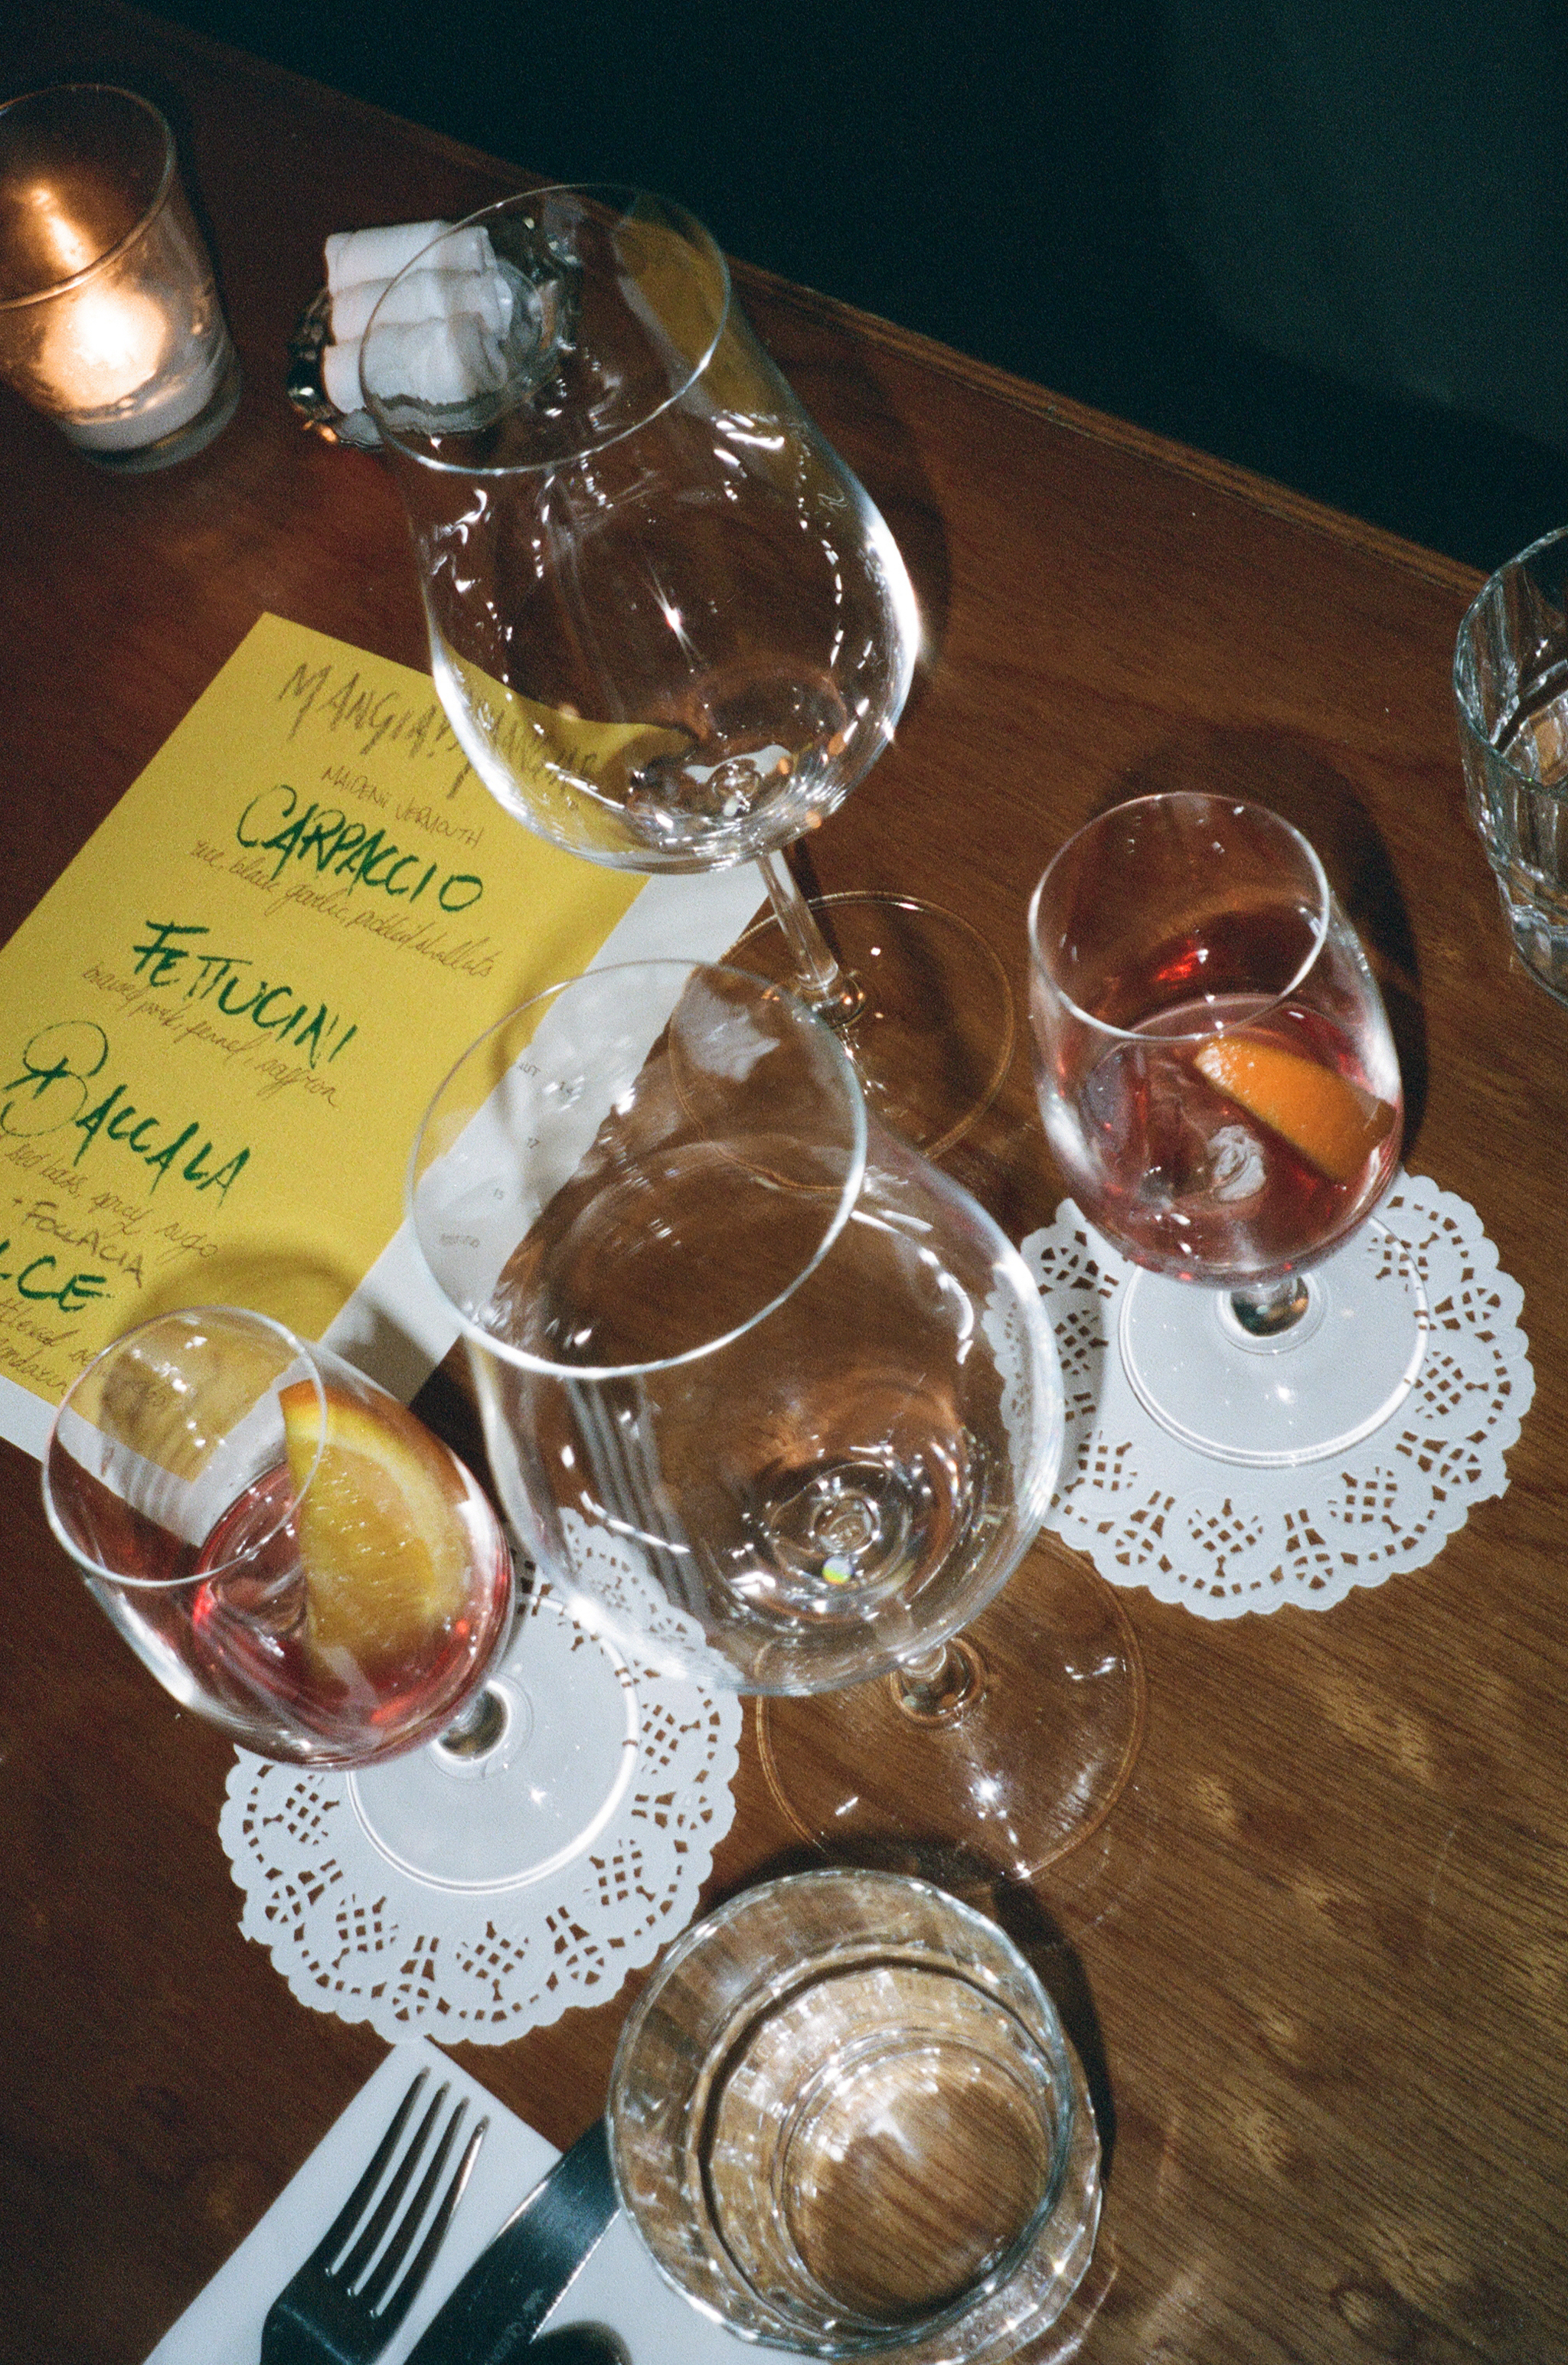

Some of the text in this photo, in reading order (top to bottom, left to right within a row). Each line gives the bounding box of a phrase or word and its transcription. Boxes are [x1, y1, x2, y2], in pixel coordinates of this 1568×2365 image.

[237, 783, 484, 912] CARPACCIO
[395, 794, 485, 848] VERMOUTH
[132, 919, 358, 1070] FETTUCINI
[1, 1020, 251, 1208] BACCALA
